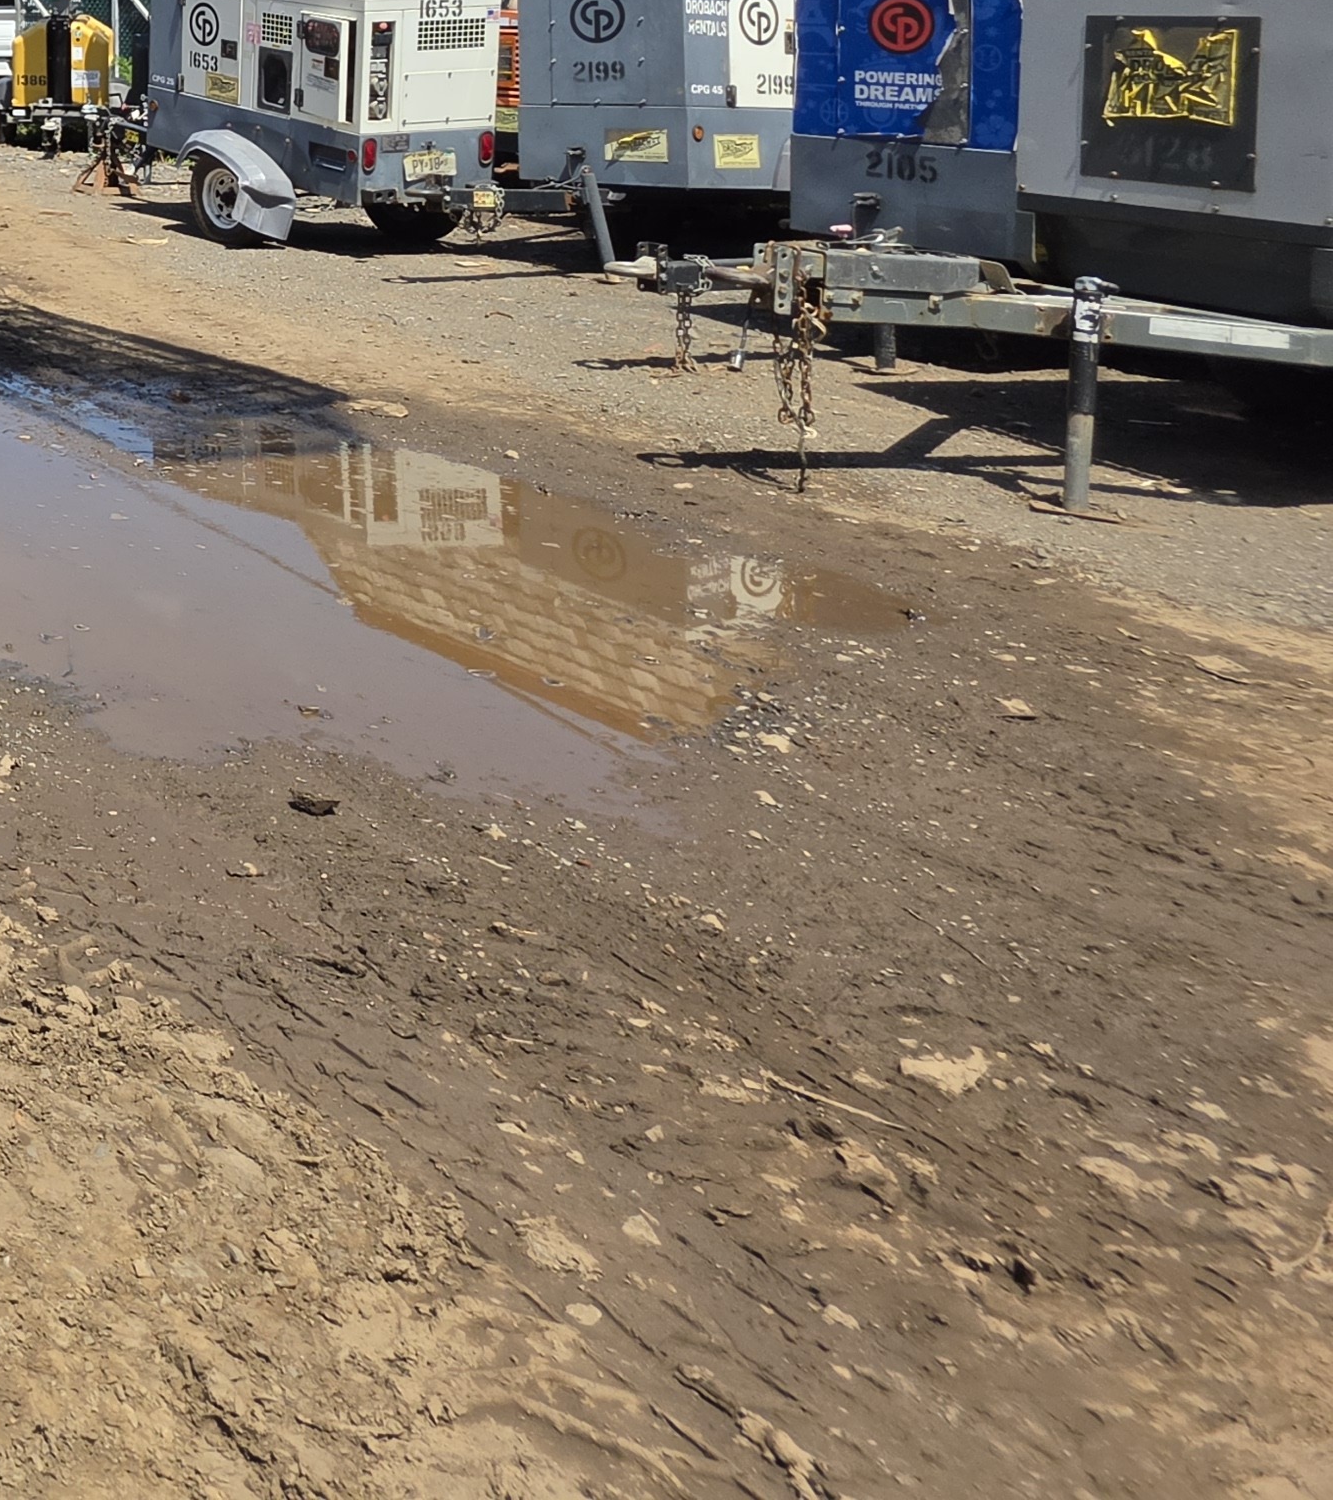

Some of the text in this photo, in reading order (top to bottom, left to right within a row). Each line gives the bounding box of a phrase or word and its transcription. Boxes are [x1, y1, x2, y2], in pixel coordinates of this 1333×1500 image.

[420, 0, 463, 19] 1653
[190, 51, 219, 72] 1653
[573, 60, 626, 83] 2199
[16, 74, 48, 87] 1386
[756, 74, 795, 95] 2199
[854, 70, 943, 87] POWERING
[691, 84, 723, 95] CPG 45
[865, 151, 938, 183] 2105
